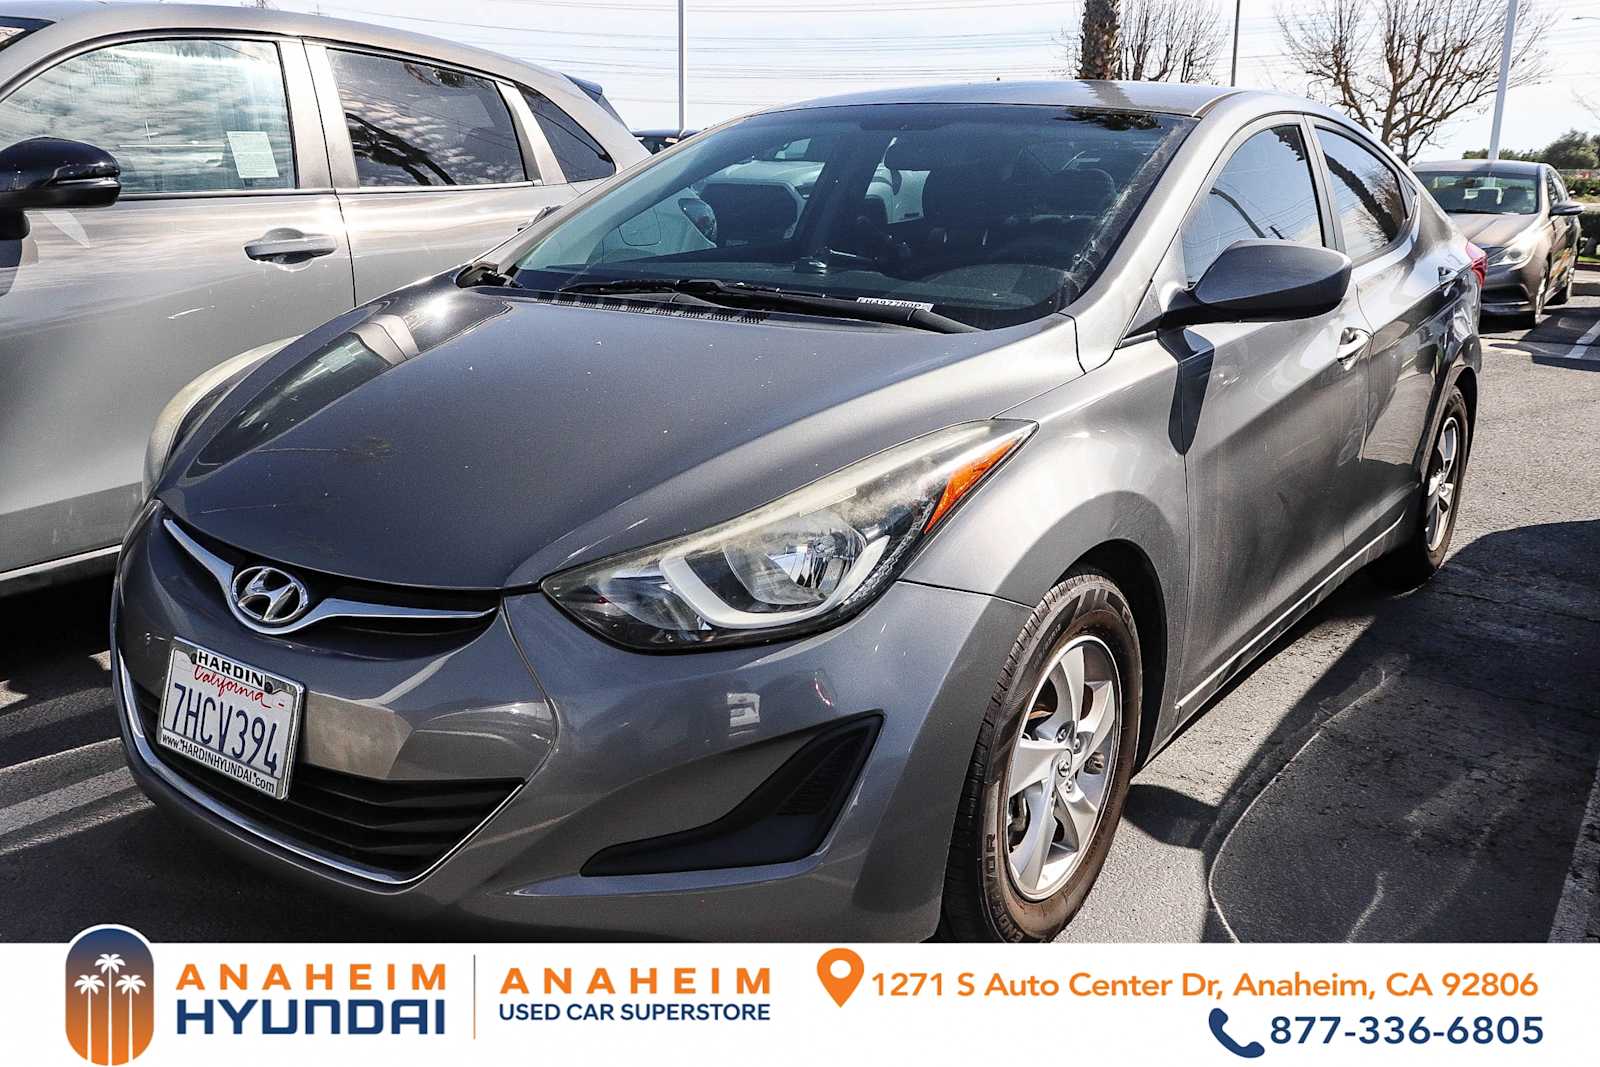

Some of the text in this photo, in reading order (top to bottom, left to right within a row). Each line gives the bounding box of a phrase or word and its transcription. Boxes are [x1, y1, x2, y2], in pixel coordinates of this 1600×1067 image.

[193, 664, 271, 709] California
[198, 651, 264, 686] HARDIN
[172, 682, 278, 777] 7HCV394
